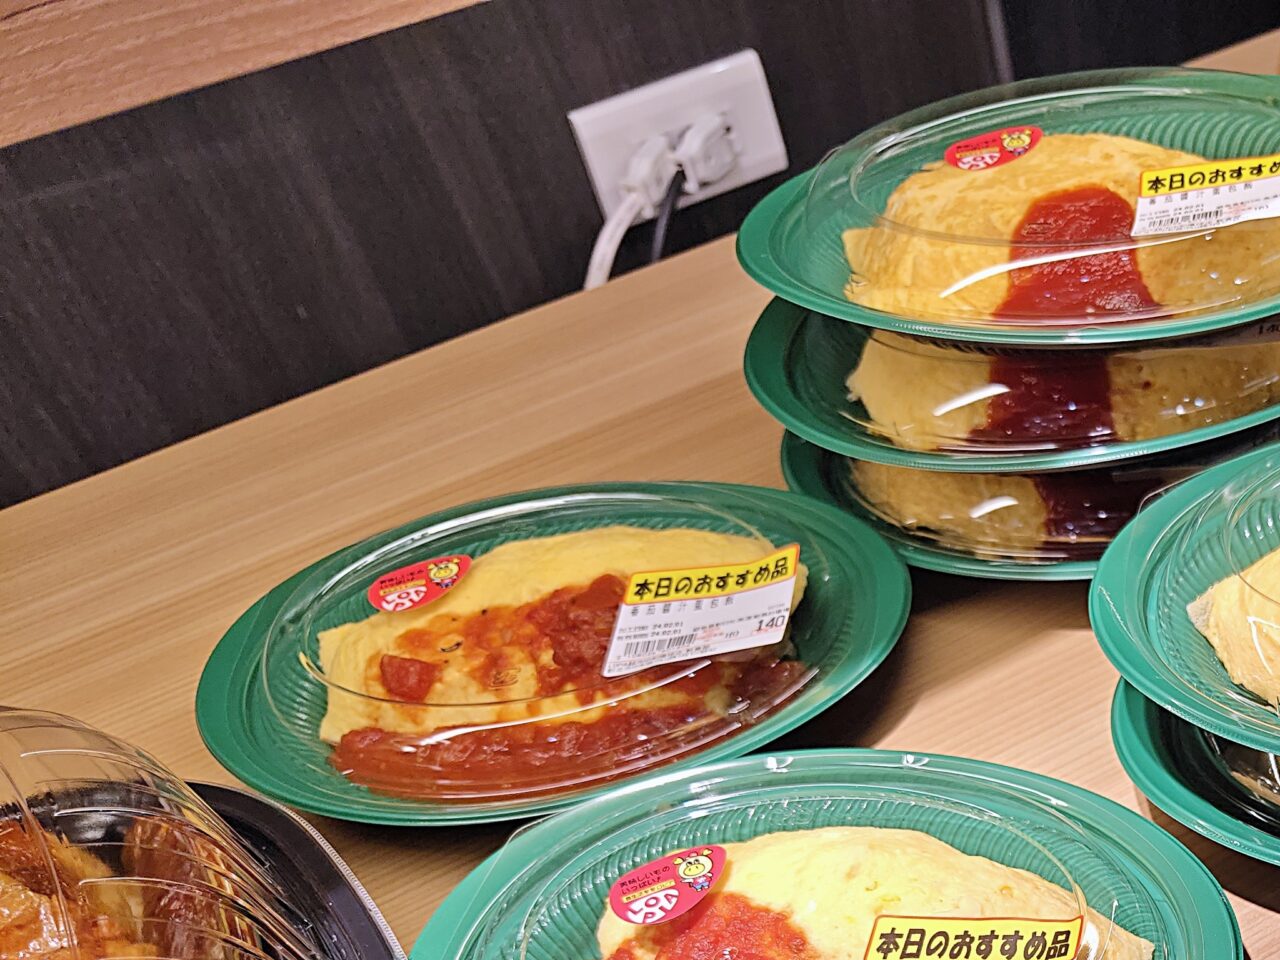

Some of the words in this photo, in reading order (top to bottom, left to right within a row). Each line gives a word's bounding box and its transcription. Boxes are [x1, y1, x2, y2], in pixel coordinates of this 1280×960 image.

[634, 557, 788, 599] 本日のおすすめ品
[757, 615, 786, 632] 140
[876, 928, 1070, 960] 本日のおすすめ品
